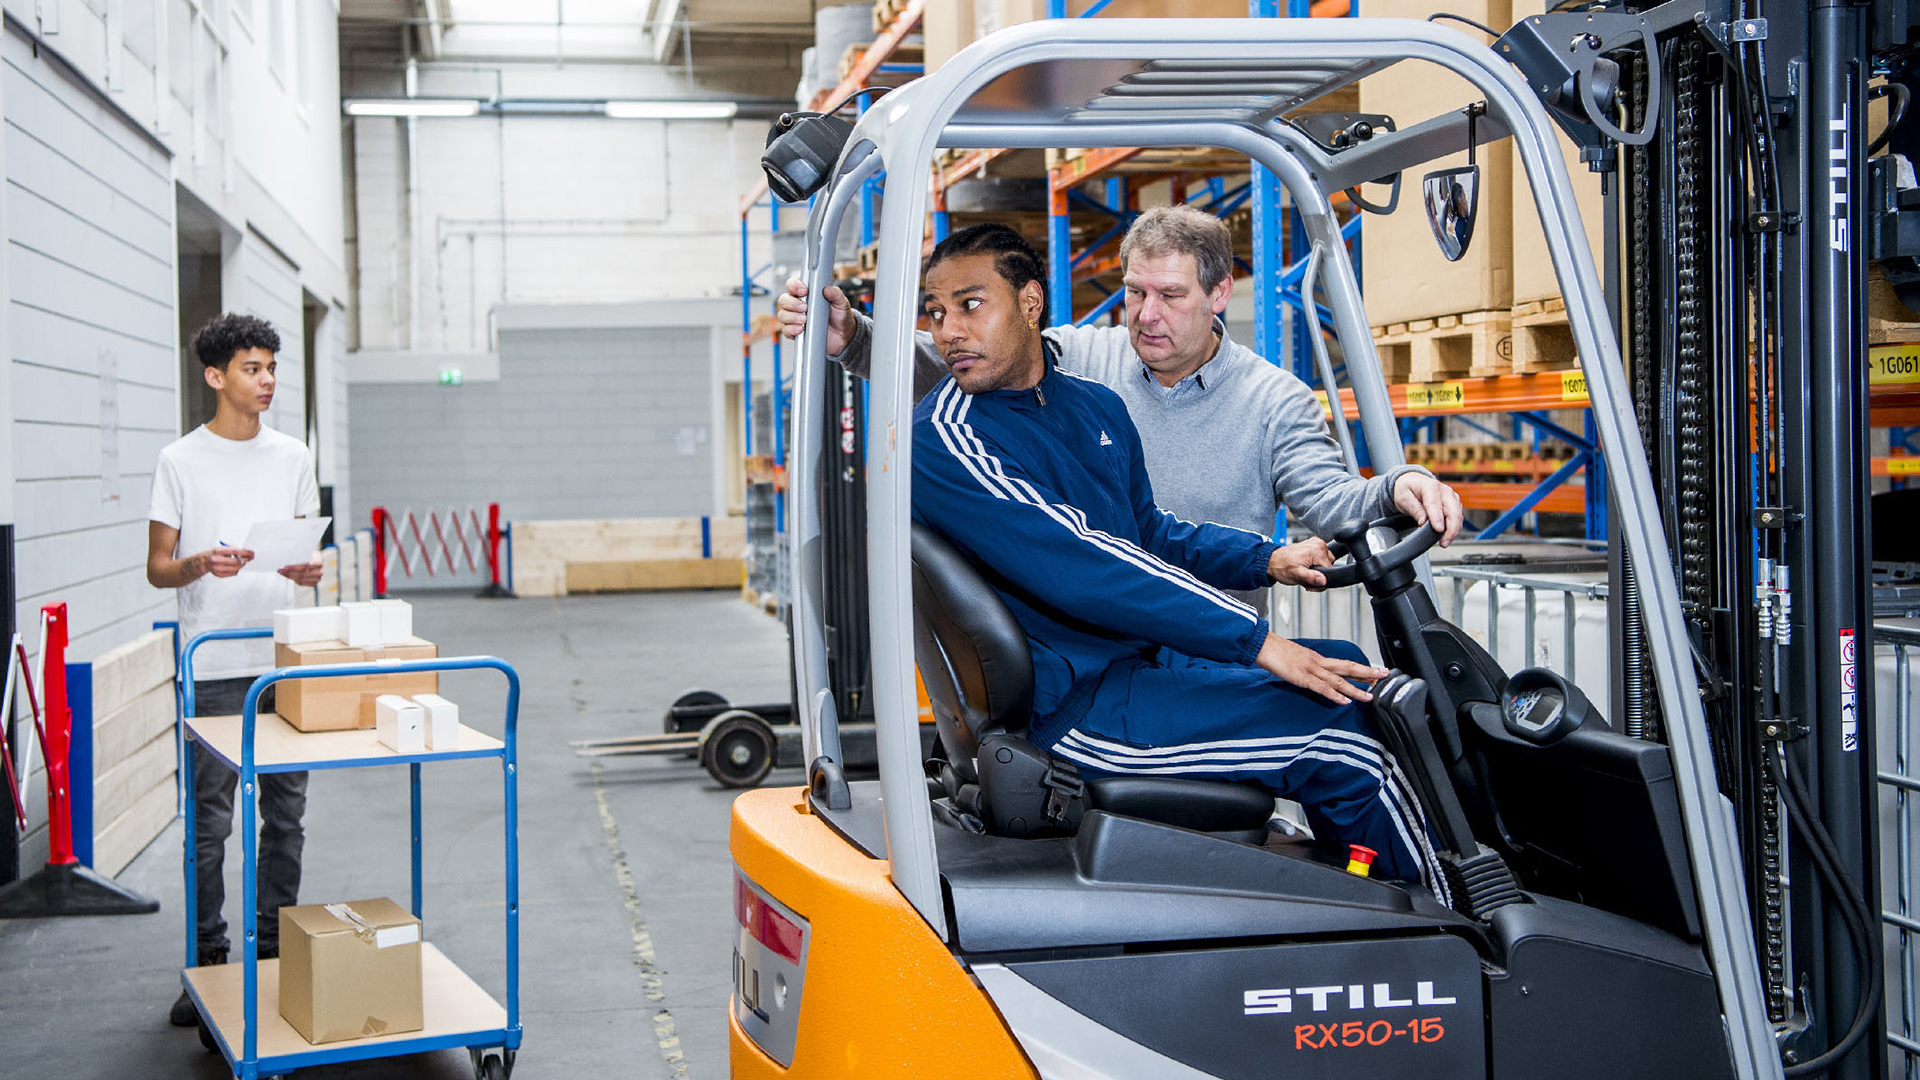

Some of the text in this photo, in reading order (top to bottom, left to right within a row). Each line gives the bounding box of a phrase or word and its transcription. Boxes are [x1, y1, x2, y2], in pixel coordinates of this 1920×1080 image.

[1829, 103, 1847, 252] STILL
[1880, 356, 1918, 374] 1G061
[1244, 981, 1457, 1015] STILL
[1294, 1017, 1445, 1050] RX50-15
